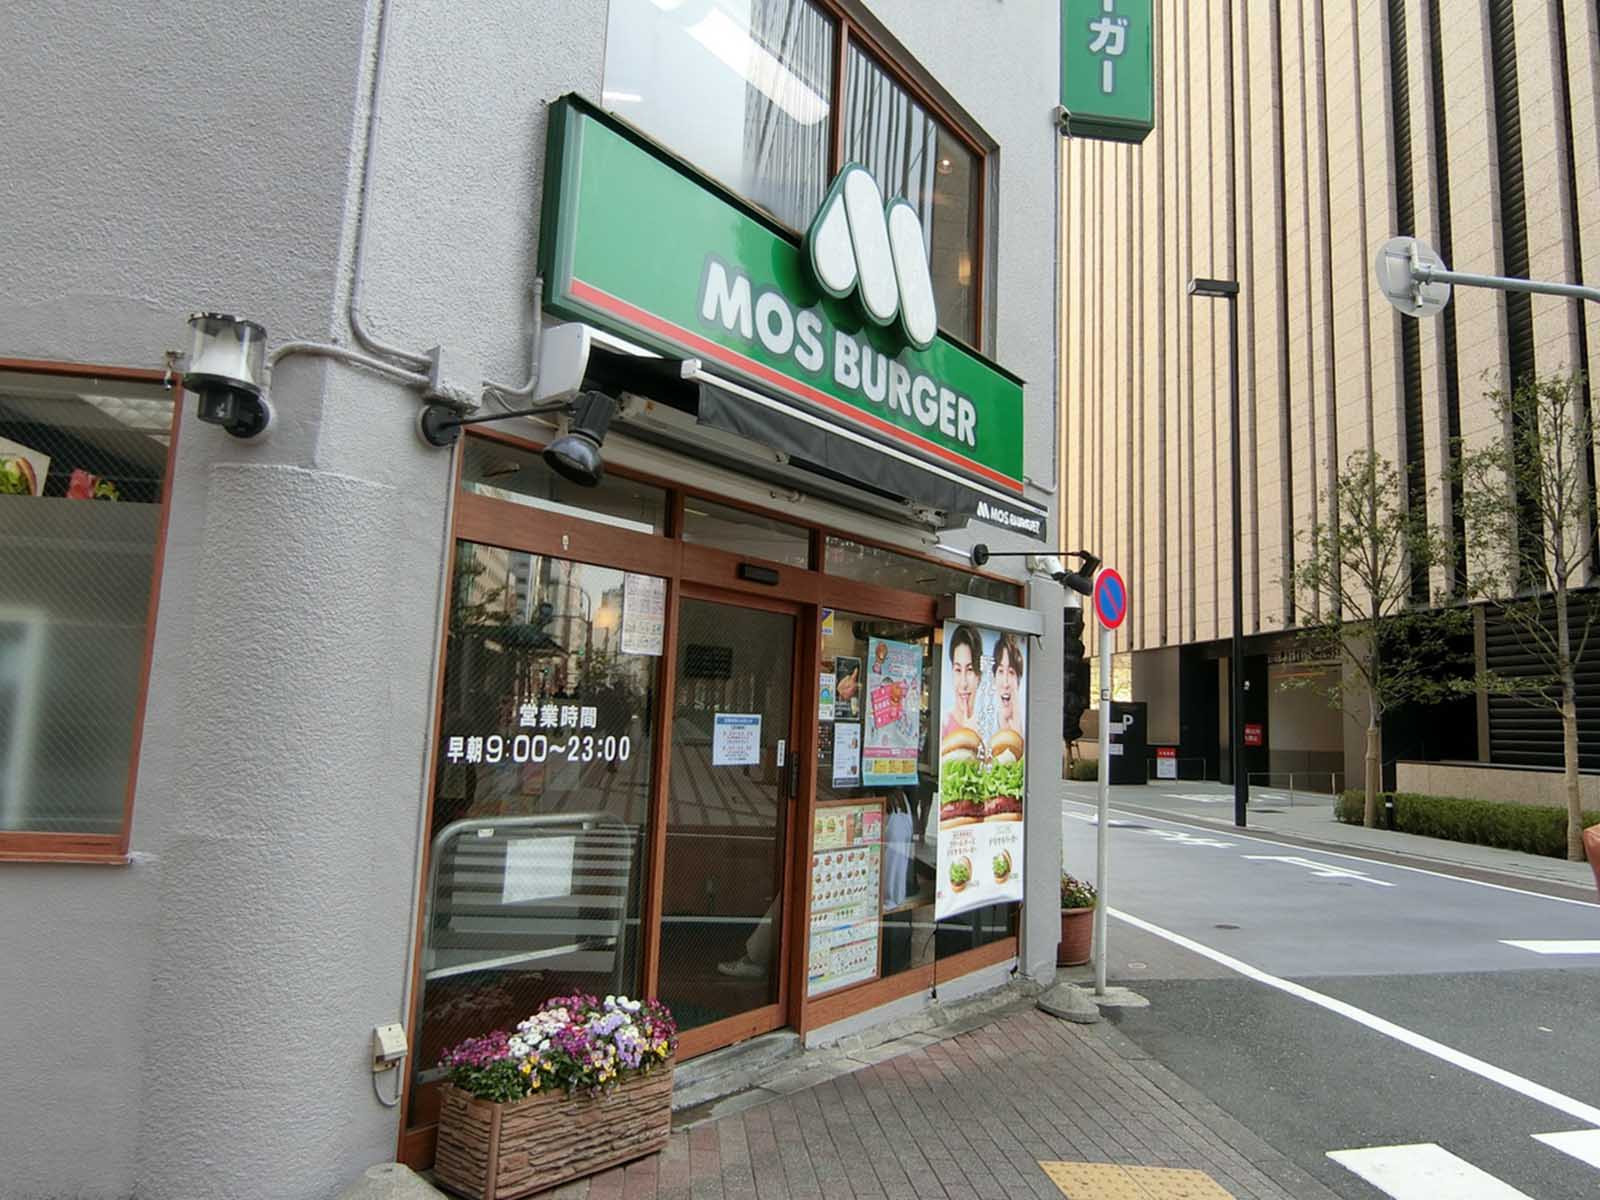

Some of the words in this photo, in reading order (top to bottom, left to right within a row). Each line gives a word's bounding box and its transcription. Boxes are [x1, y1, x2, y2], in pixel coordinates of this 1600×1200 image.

[702, 261, 824, 371] MOS
[833, 331, 977, 447] BURGER
[991, 506, 1009, 525] MOS
[519, 703, 597, 729] 営業時間
[1122, 714, 1134, 731] P
